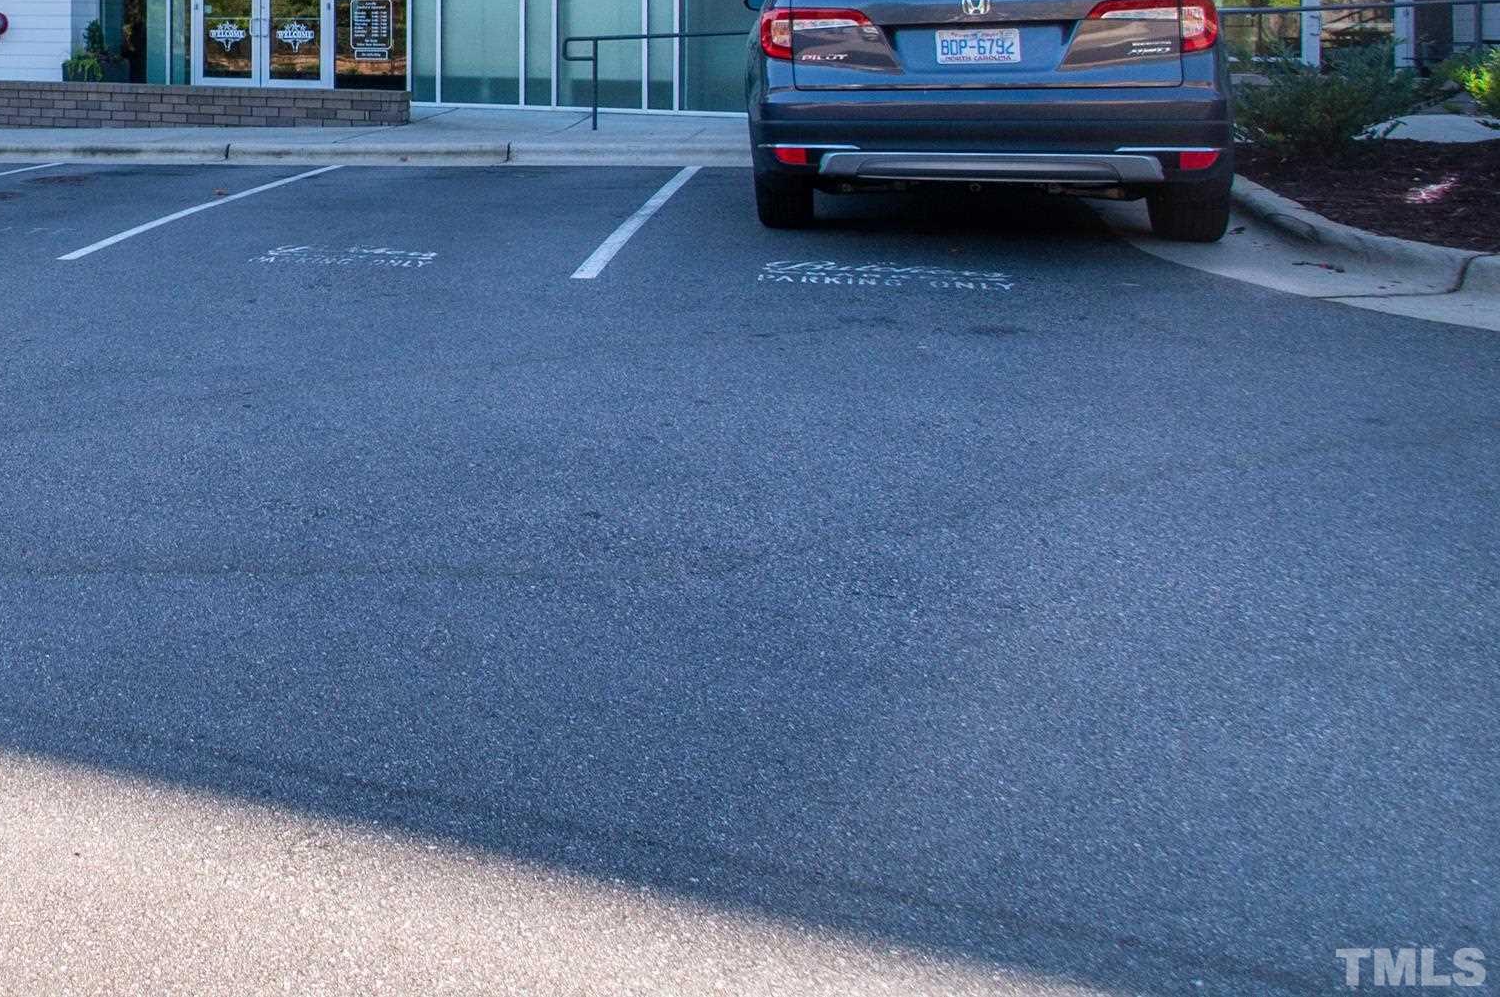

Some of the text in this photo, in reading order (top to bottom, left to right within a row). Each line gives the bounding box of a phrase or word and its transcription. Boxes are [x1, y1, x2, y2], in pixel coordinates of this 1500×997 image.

[210, 30, 246, 38] WELCOME
[277, 31, 314, 39] WELCOME
[757, 274, 903, 286] PARKING
[929, 280, 1015, 290] ONLY
